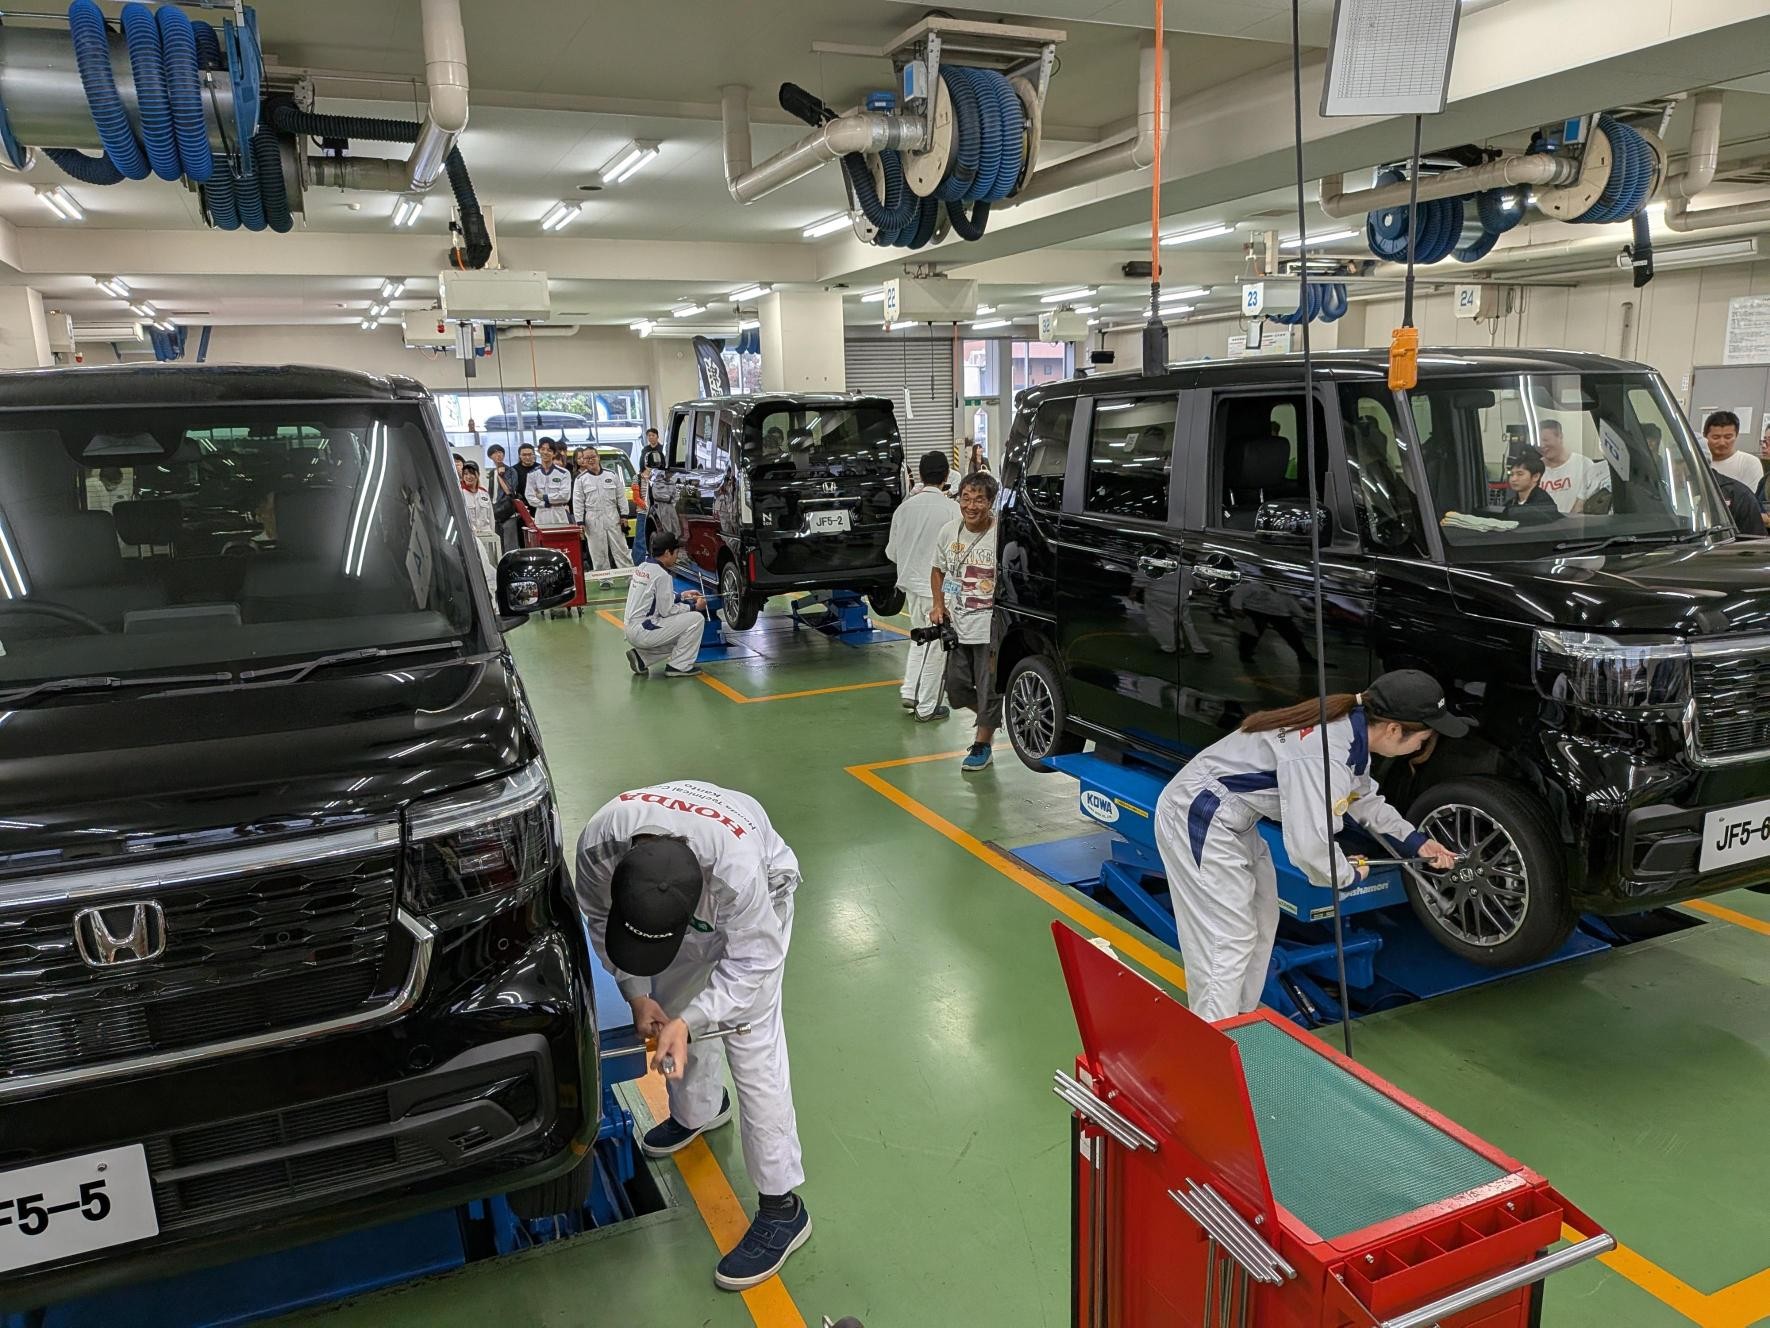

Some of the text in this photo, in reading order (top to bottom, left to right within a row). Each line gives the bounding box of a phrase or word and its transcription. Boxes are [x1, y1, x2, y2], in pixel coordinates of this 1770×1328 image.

[887, 287, 896, 309] 22
[1247, 290, 1258, 307] 23
[1460, 290, 1474, 307] 24
[762, 512, 772, 522] N
[816, 516, 844, 527] JF5-2
[684, 783, 722, 798] Kanto
[1087, 793, 1113, 814] KOWA
[619, 792, 747, 840] HONDA
[624, 921, 674, 939] HONDA
